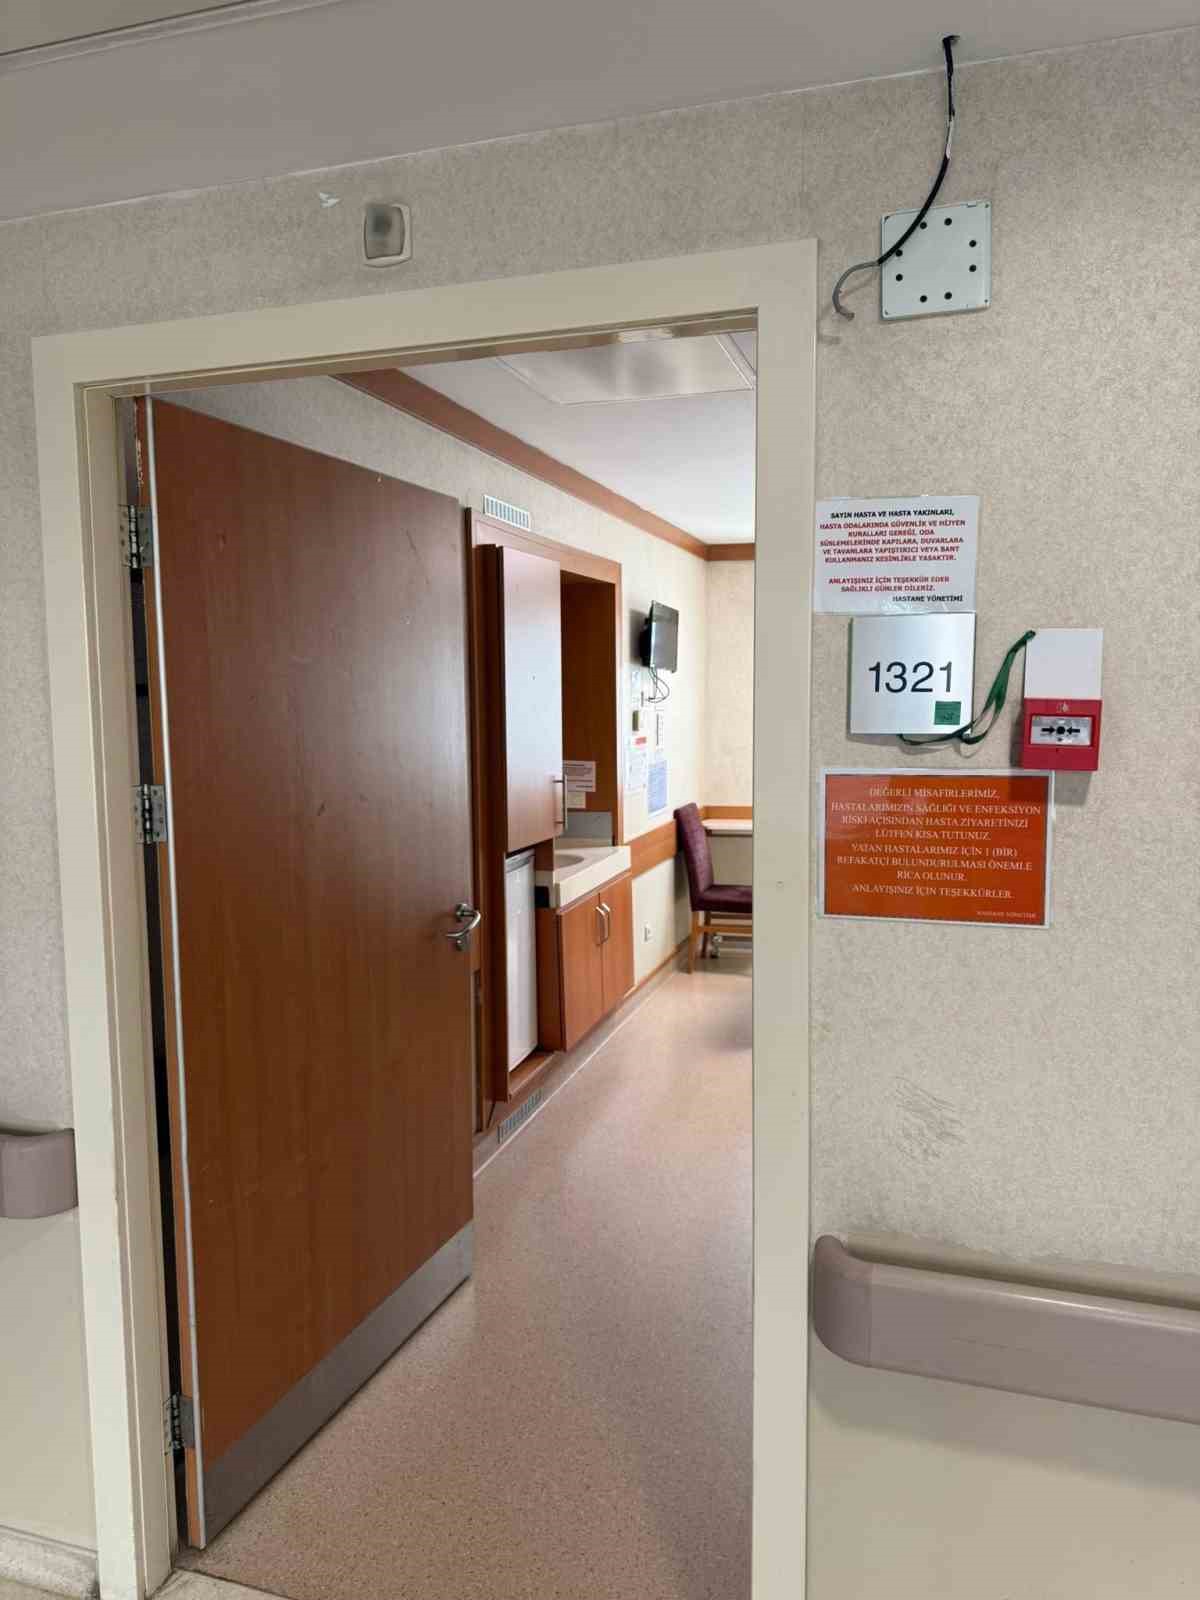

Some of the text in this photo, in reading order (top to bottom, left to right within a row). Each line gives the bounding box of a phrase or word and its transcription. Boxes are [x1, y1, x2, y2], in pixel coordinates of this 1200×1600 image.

[913, 509, 954, 517] YAKINLARI,
[876, 576, 891, 584] İÇİN
[875, 584, 902, 592] GÜNLER
[868, 661, 953, 693] 1321
[960, 805, 972, 813] VE
[975, 805, 1041, 815] ENFEKSİYON
[870, 817, 924, 827] AÇISINDAN
[926, 817, 958, 826] HASTA
[875, 829, 913, 838] LÜTFEN
[915, 830, 939, 839] KISA
[851, 843, 882, 852] YATAN
[884, 844, 958, 855] HASTALARIMIZ
[961, 845, 982, 856] İÇİN
[892, 858, 986, 869] BULUNDURULMASI
[988, 859, 1033, 871] ÖNEMLE
[897, 870, 920, 880] RİCA
